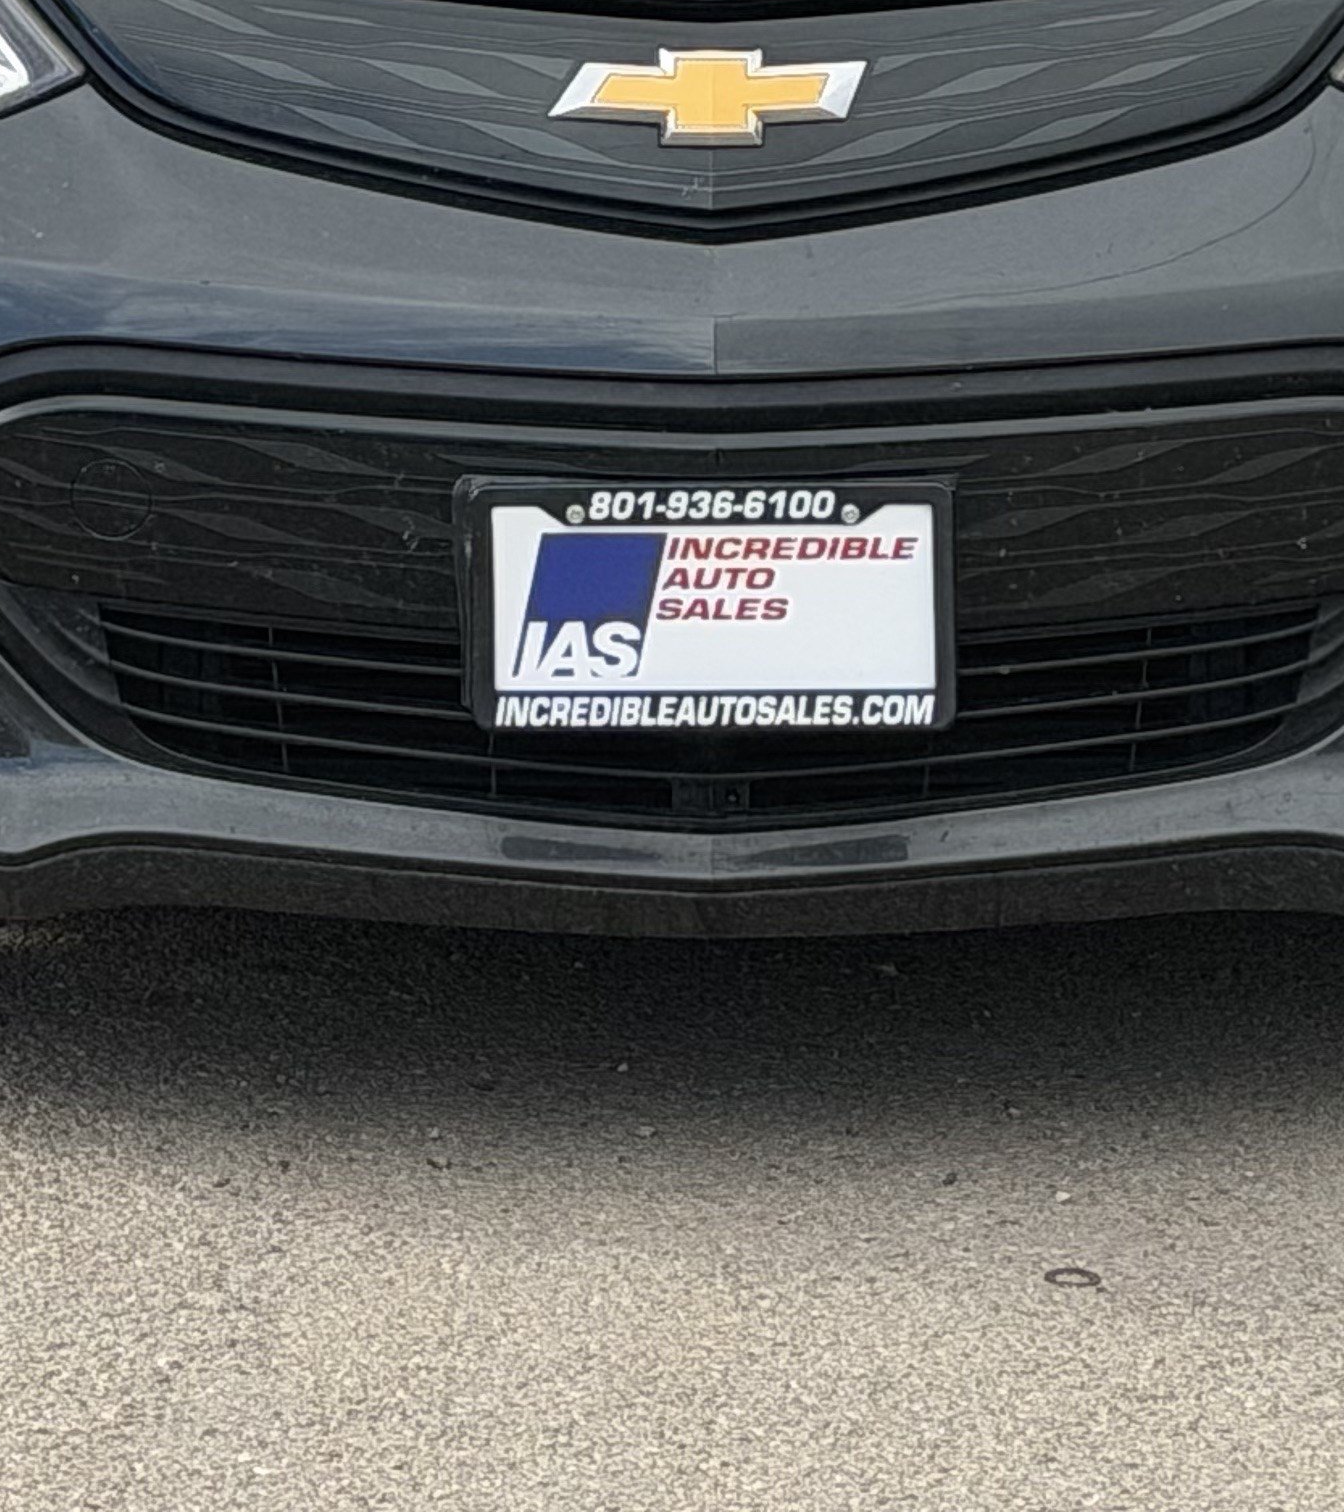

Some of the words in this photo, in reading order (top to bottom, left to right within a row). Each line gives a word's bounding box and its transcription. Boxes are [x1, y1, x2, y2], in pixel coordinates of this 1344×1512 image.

[589, 491, 836, 521] 801-936-6100
[665, 536, 919, 561] INCREDIBLE
[661, 566, 776, 590] AUTO
[655, 598, 789, 621] SALES
[518, 621, 641, 678] IAS
[495, 694, 936, 728] INCREDIBLEAUTOSALES.COM
